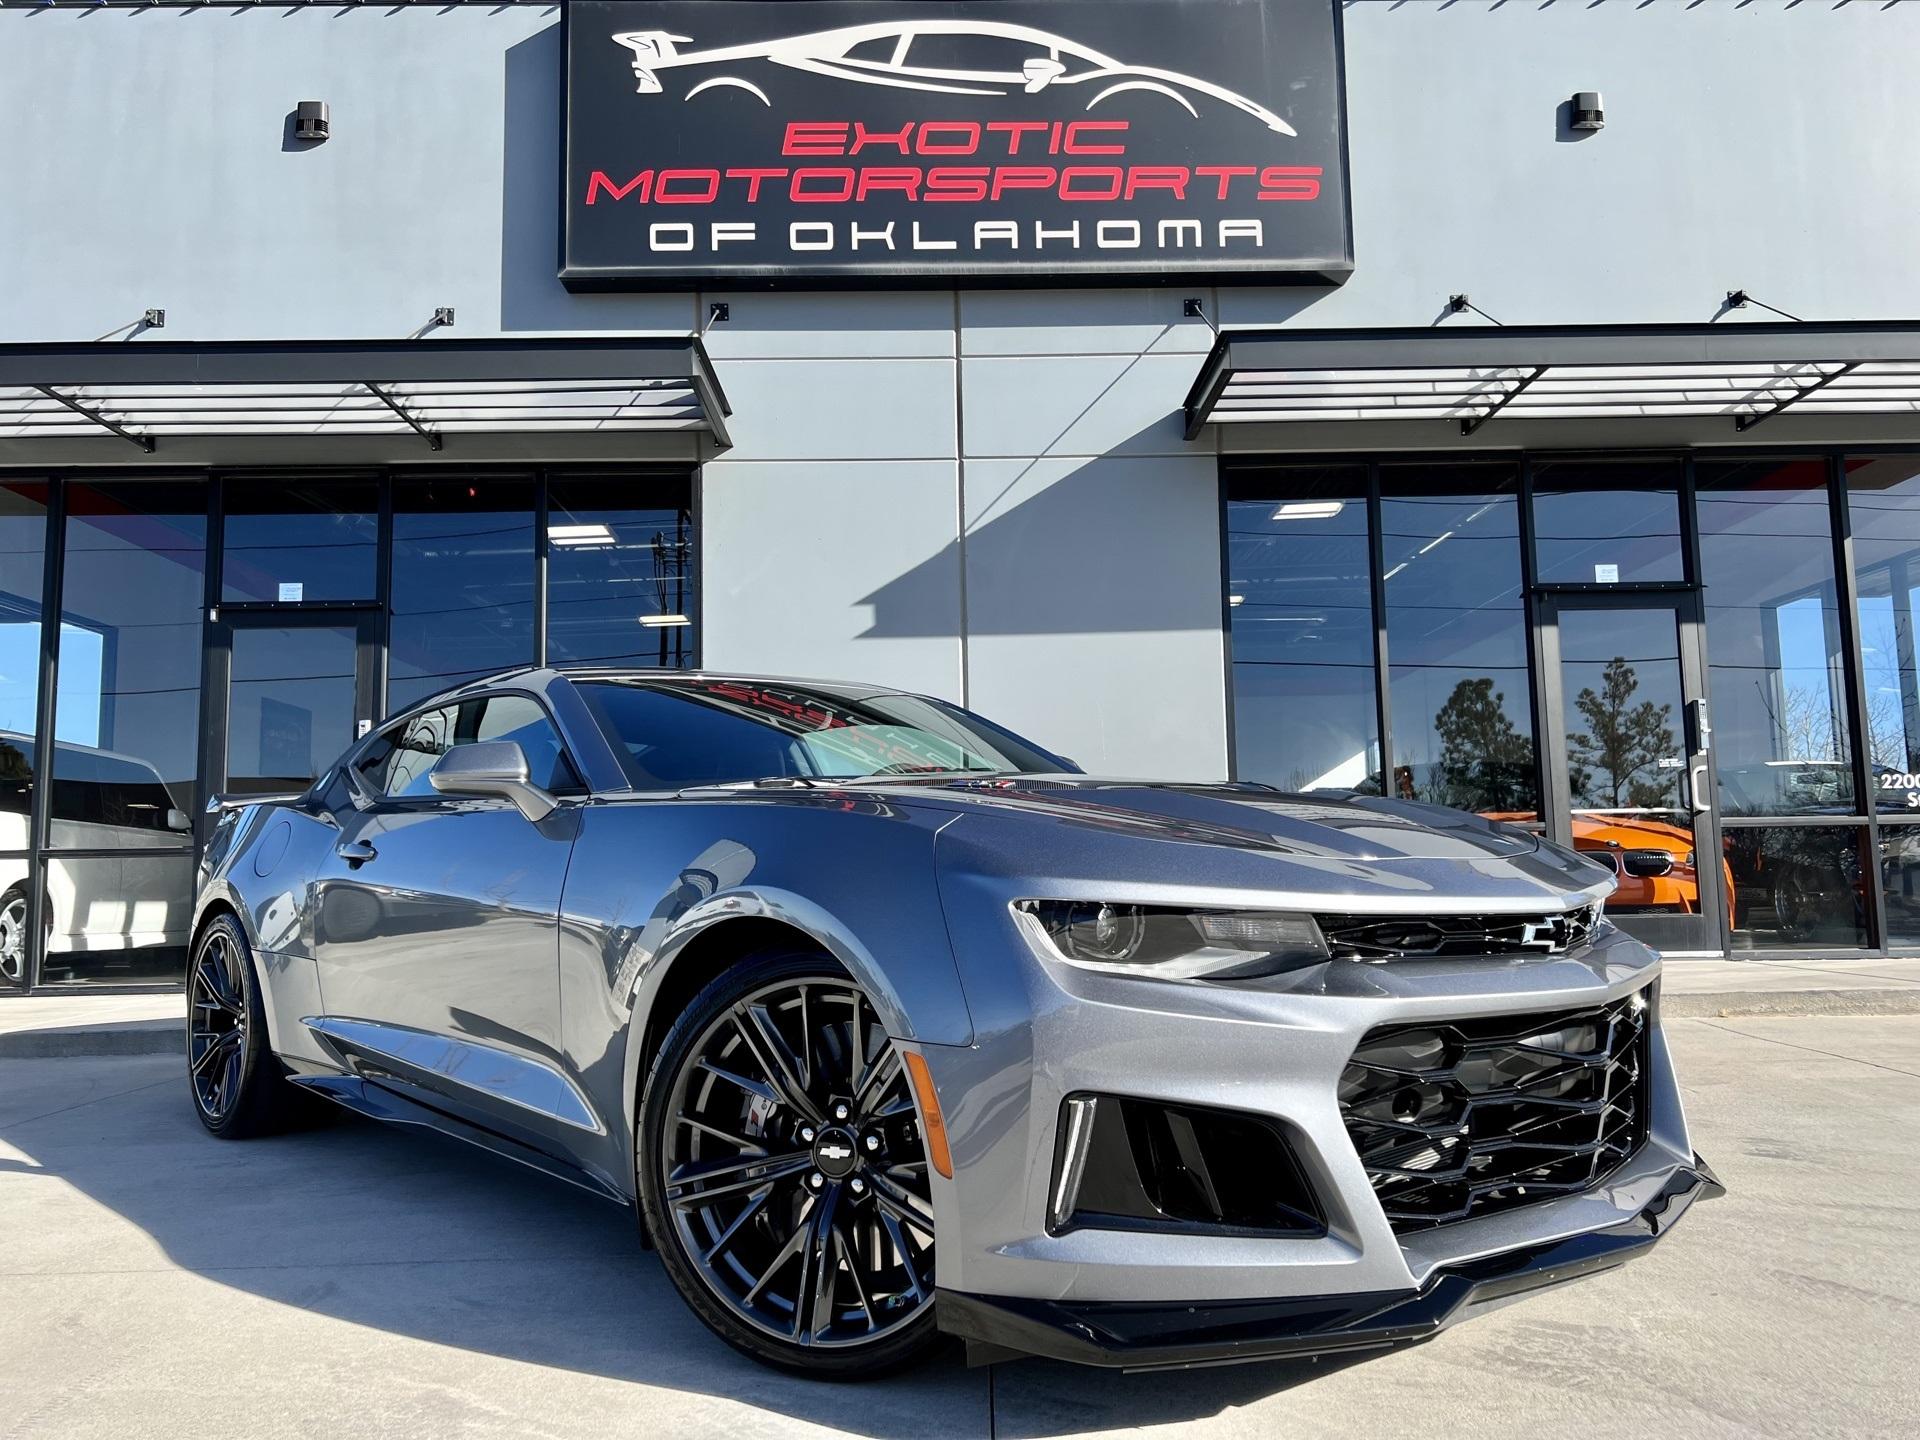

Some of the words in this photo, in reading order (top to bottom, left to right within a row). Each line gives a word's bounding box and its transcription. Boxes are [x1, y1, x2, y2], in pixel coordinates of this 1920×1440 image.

[782, 120, 1128, 156] EXOTIC
[586, 165, 1322, 205] MOTORSPORTS
[649, 221, 756, 251] OF
[789, 218, 1264, 251] OKLAHOMA
[1907, 791, 1920, 807] S
